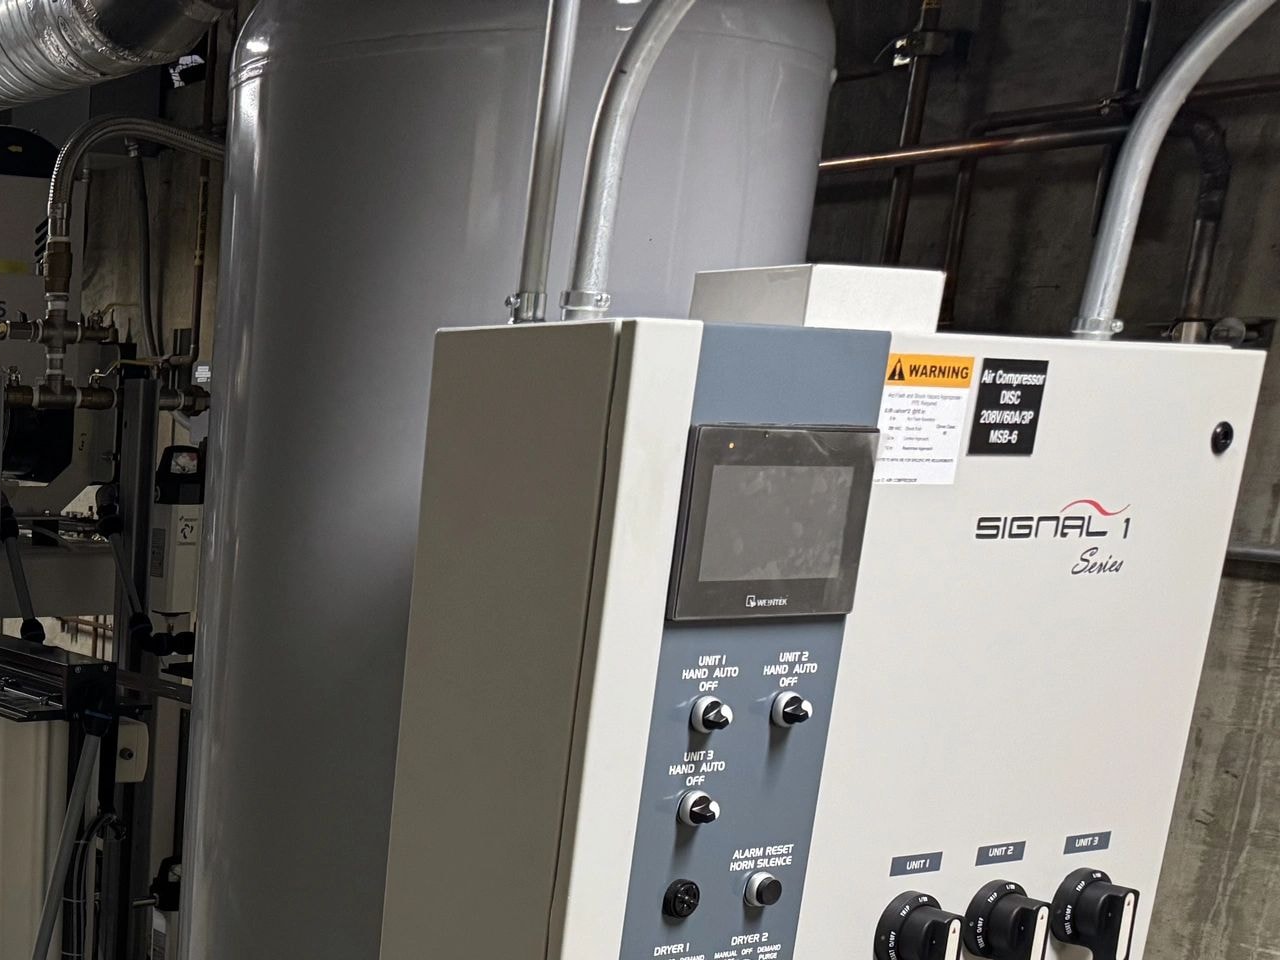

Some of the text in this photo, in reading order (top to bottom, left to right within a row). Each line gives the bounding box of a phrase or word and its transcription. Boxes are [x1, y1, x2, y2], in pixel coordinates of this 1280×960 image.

[909, 365, 969, 379] WARNING
[981, 370, 1046, 387] Air Compressor
[1000, 390, 1021, 404] DISC
[980, 410, 1034, 424] 208V/60A/3P
[988, 429, 1018, 444] MSB-6
[975, 515, 1131, 539] SIGNAL 1
[1071, 547, 1124, 575] Series
[698, 655, 726, 666] UNIT 1
[779, 651, 809, 662] UNIT 2
[682, 667, 739, 679] HAND AUTO
[763, 663, 818, 676] HAND AUTO
[699, 681, 718, 692] OFF
[780, 676, 798, 688] OFF
[684, 750, 714, 762] UNIT 3
[668, 761, 725, 775] HAND AUTO
[686, 775, 705, 786] OFF
[1075, 836, 1099, 847] UNIT 3
[733, 844, 794, 860] ALARM RESET
[988, 846, 1014, 856] UNIT 2
[729, 856, 792, 872] HORN SILENCE
[906, 859, 925, 870] UNIT
[987, 892, 998, 903] TRIP
[899, 905, 911, 917] TRIP
[731, 932, 768, 946] DRYER 2
[654, 944, 684, 956] DRYER
[714, 950, 737, 959] MANUAL
[757, 944, 781, 953] DEMAND
[758, 952, 778, 960] PURGE
